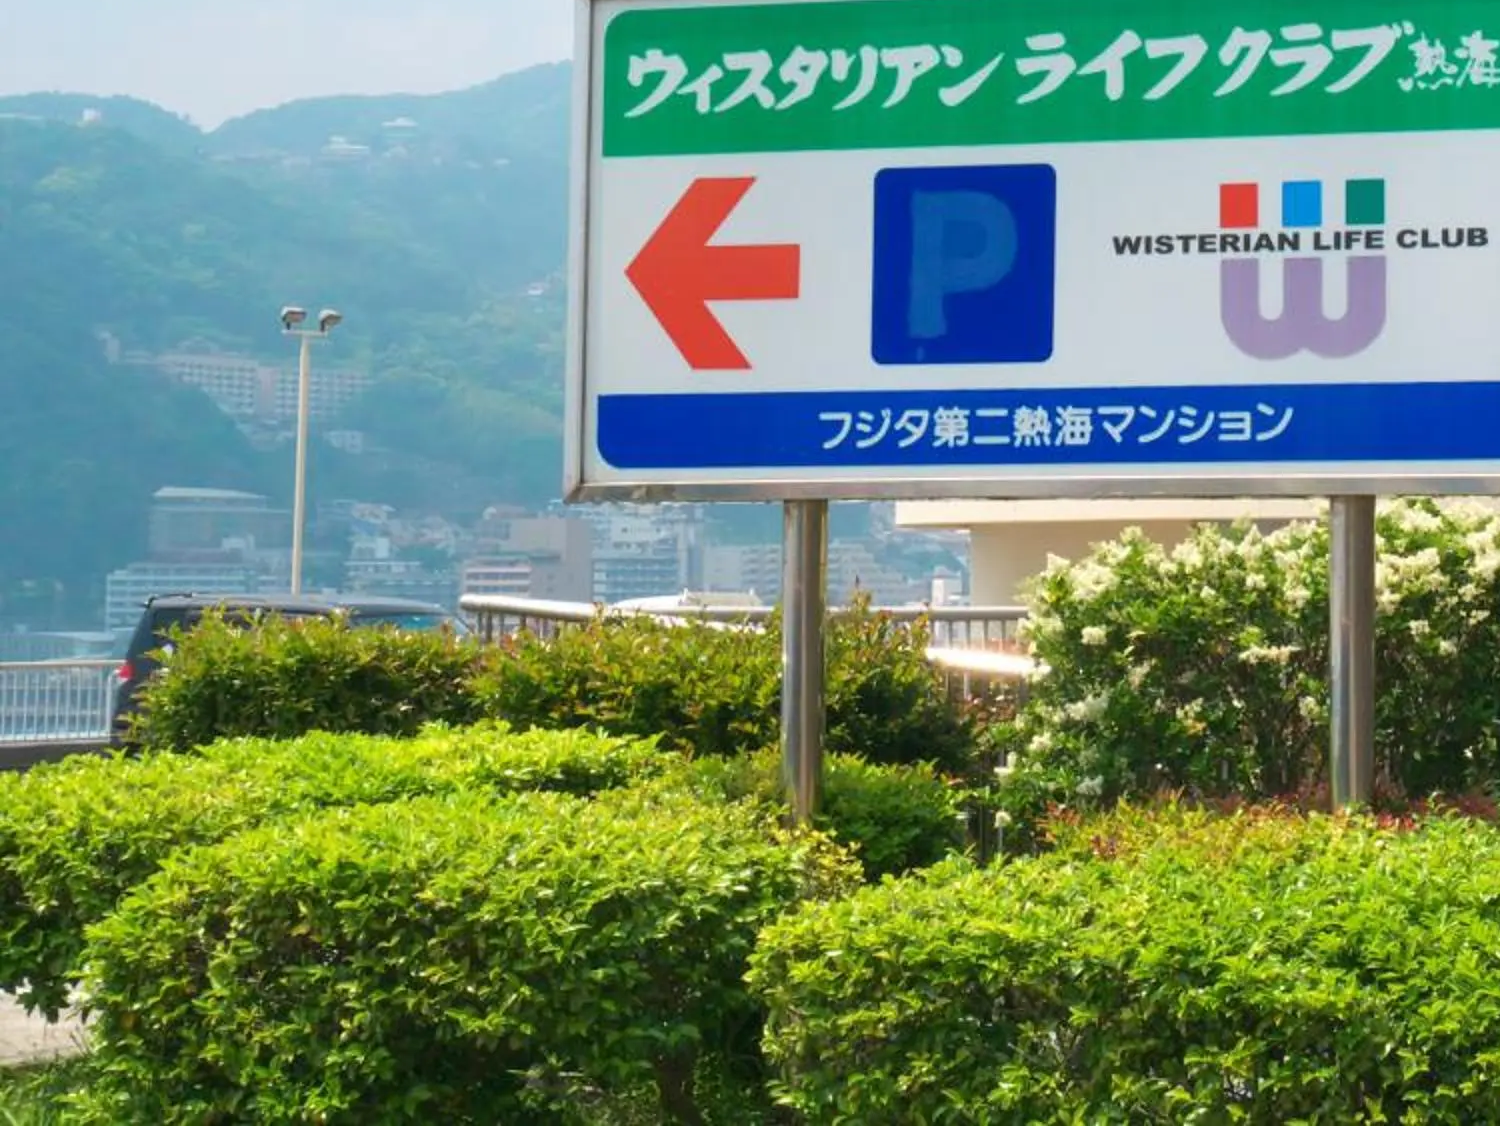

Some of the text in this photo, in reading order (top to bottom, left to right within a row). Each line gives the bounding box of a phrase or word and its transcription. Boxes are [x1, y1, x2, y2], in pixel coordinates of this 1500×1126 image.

[908, 190, 1018, 339] P
[1112, 227, 1489, 255] WISTERIAN LIFE CLUB
[818, 402, 1295, 449] フジタ第二熱海マンション
